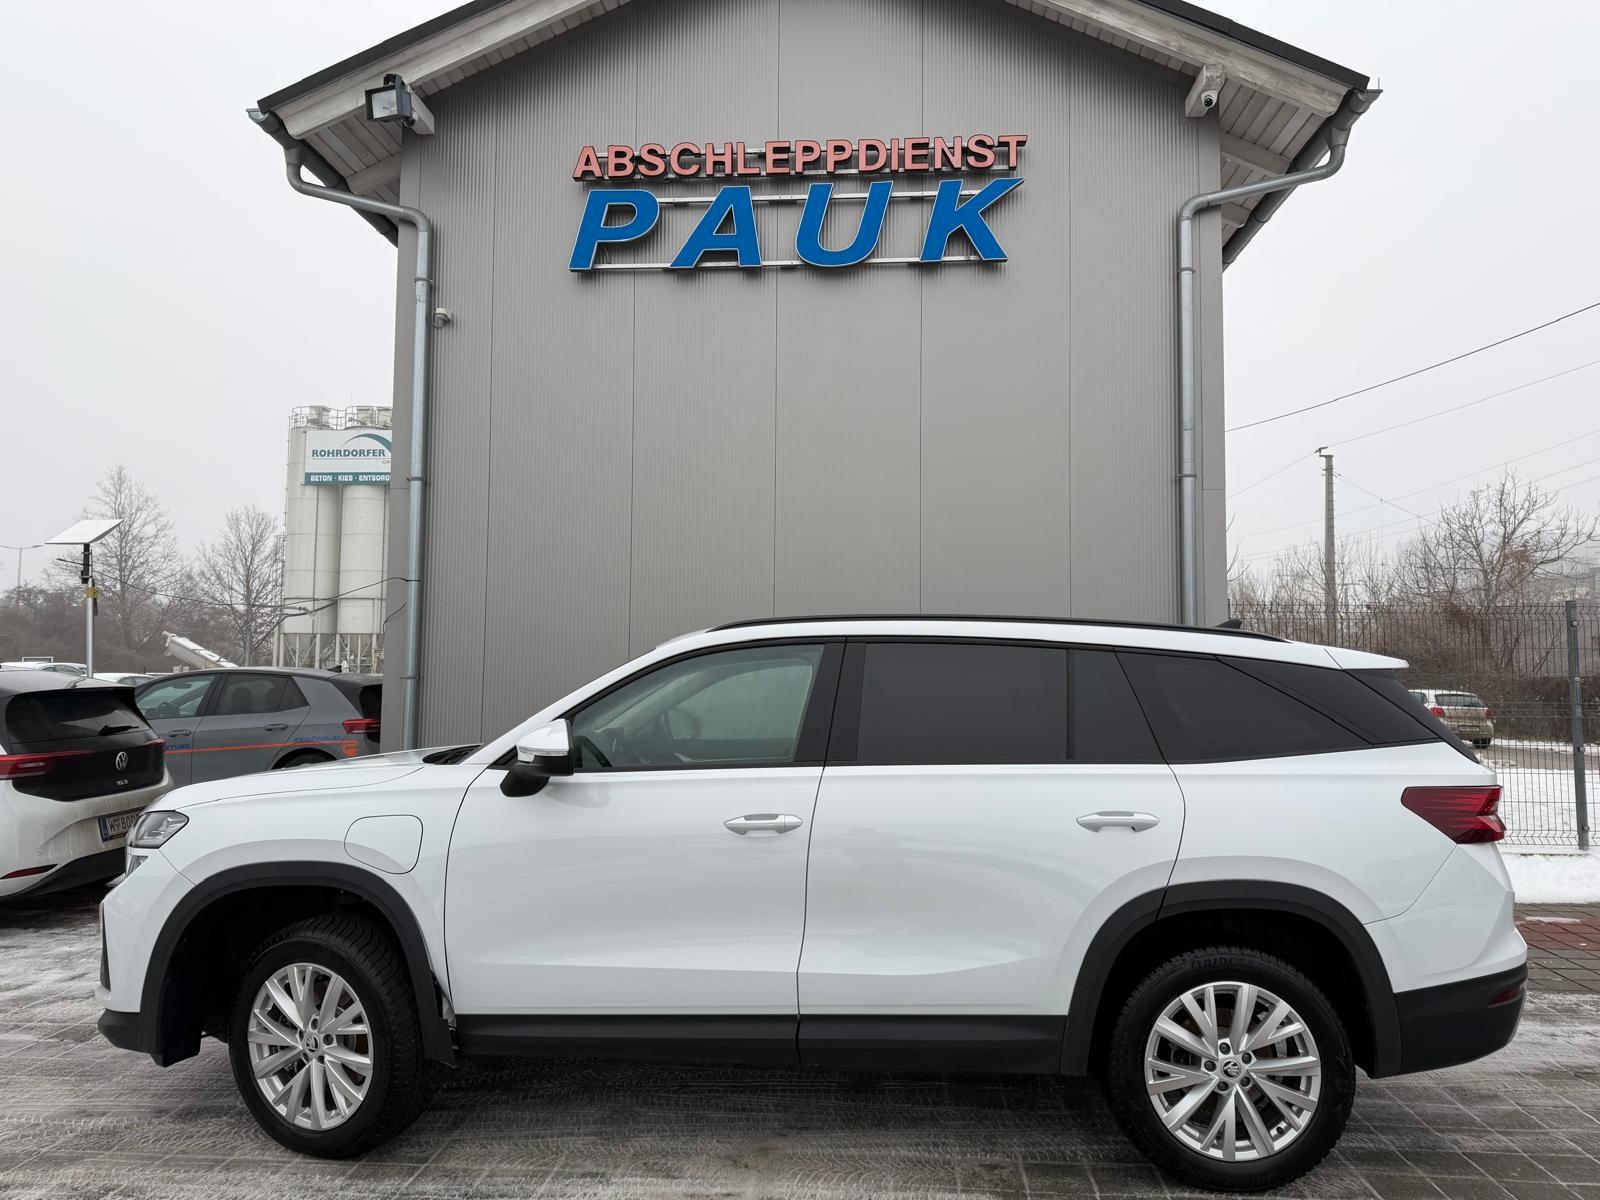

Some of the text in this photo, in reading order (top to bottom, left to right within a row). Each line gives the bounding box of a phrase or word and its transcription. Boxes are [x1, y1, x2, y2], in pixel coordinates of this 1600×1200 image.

[572, 134, 1028, 181] ABSCHLEPPDIENST
[568, 176, 1025, 271] PAUK
[312, 449, 386, 457] ROHRDORFER
